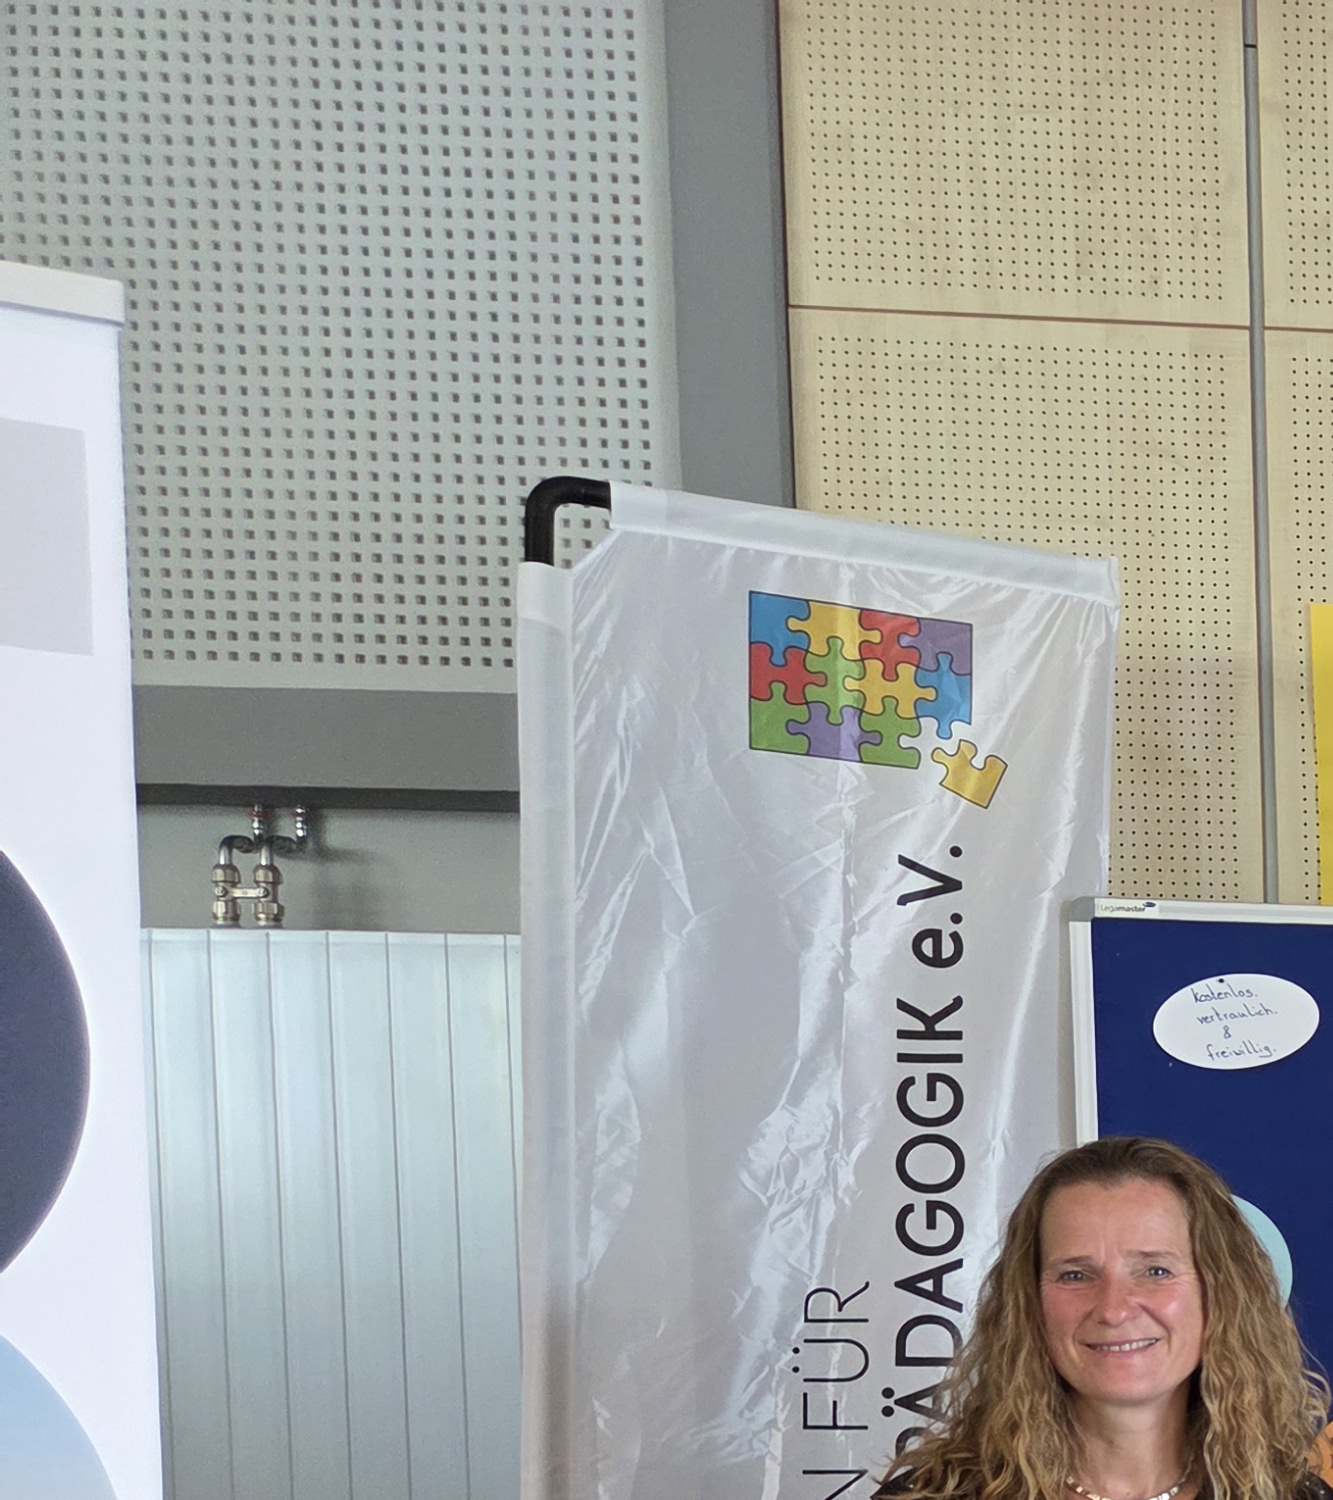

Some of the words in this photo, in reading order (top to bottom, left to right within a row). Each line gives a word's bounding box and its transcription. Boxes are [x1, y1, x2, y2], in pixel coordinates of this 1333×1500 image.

[897, 845, 963, 967] e.V.
[1222, 1025, 1232, 1039] &
[792, 1280, 868, 1431] FÜR
